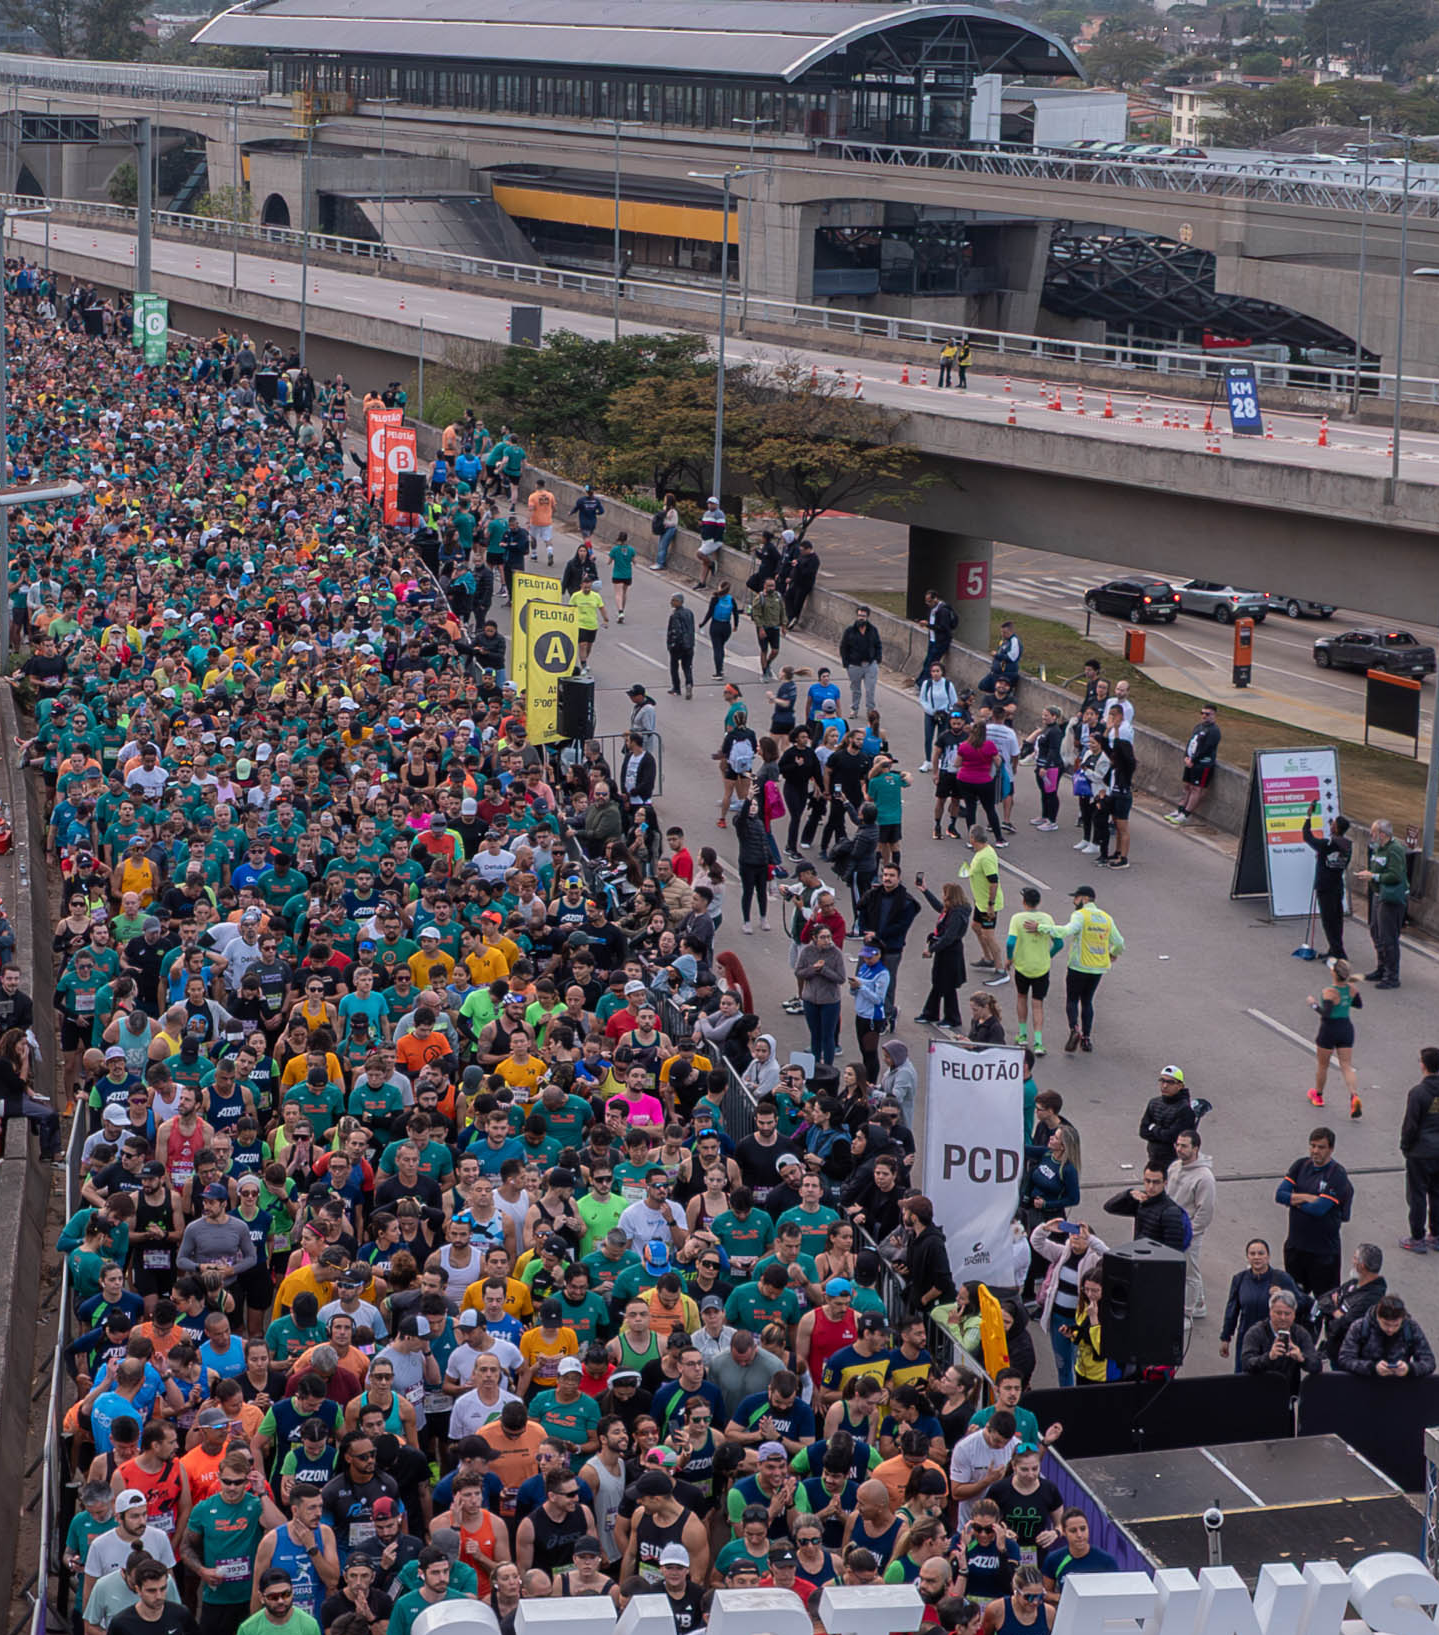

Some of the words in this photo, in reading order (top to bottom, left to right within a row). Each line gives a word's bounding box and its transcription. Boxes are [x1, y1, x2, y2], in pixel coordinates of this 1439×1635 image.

[1231, 382, 1252, 395] KM
[1232, 398, 1257, 418] 28
[396, 451, 409, 469] B
[518, 578, 559, 592] PELOTÃO
[967, 567, 982, 595] 5
[533, 608, 575, 624] PELOTÃO
[545, 637, 567, 664] A
[941, 1059, 1020, 1081] PELOTÃO
[943, 1144, 1020, 1184] PCD
